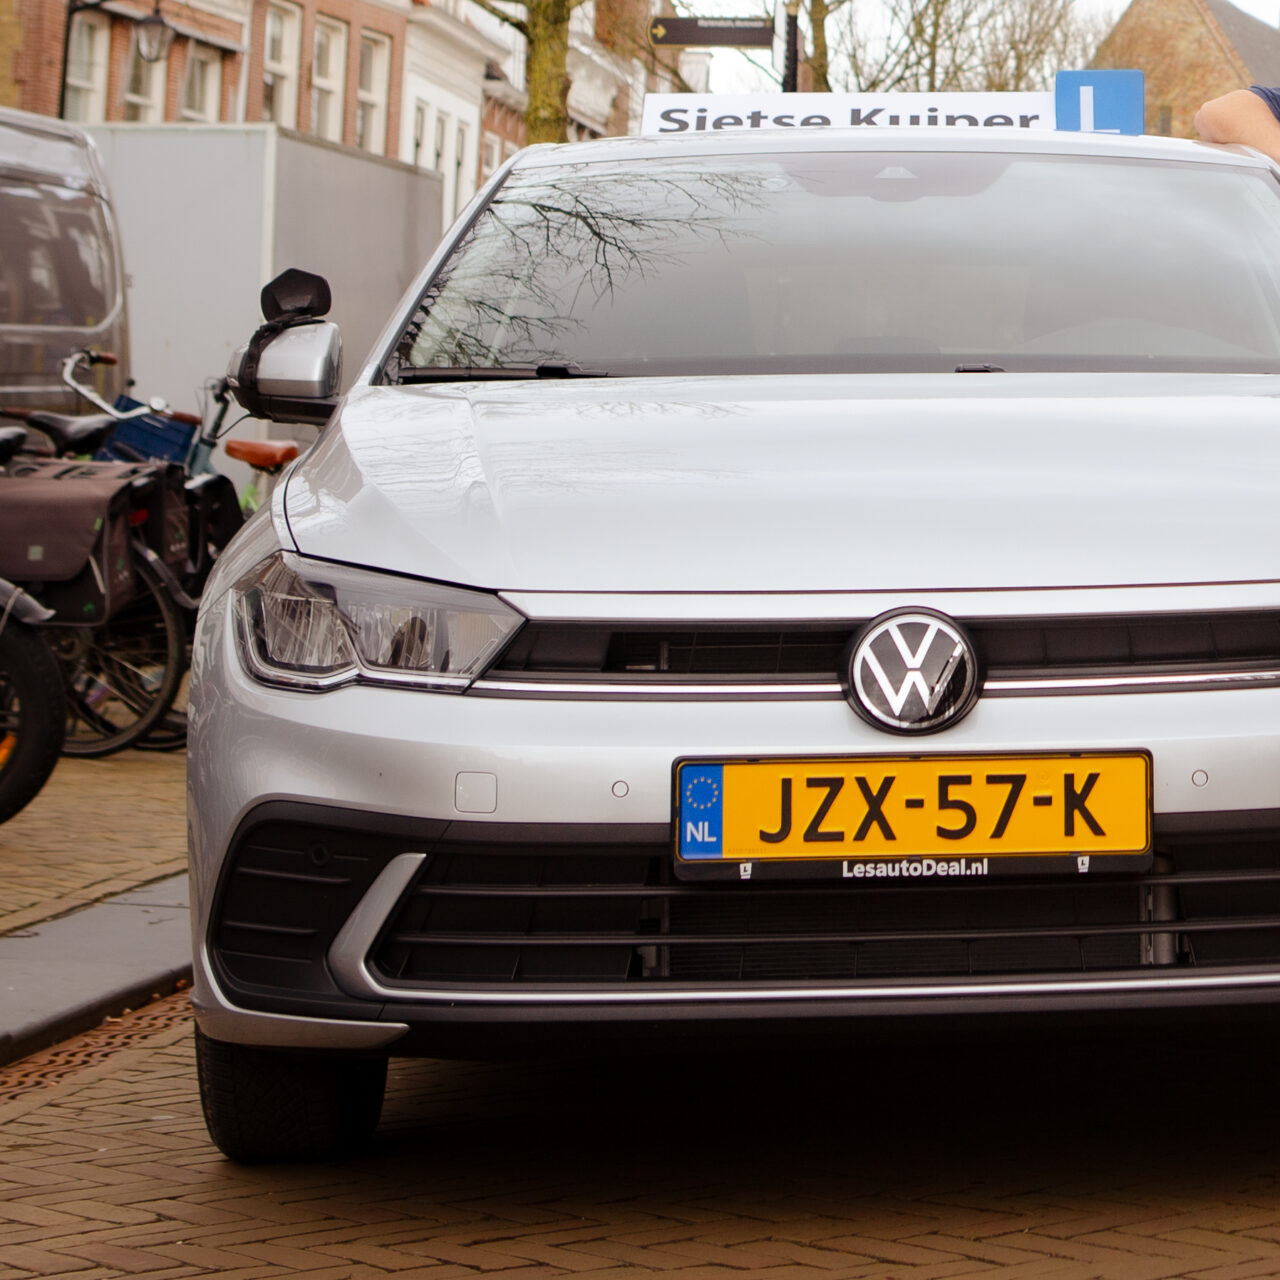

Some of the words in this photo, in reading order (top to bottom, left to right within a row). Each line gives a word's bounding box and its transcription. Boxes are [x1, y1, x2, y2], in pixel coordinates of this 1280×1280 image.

[658, 107, 831, 133] Sietse
[1079, 85, 1120, 134] L
[759, 772, 1107, 844] JZX-57-K
[686, 820, 717, 842] NL
[842, 858, 988, 877] LesautoDeal.nl
